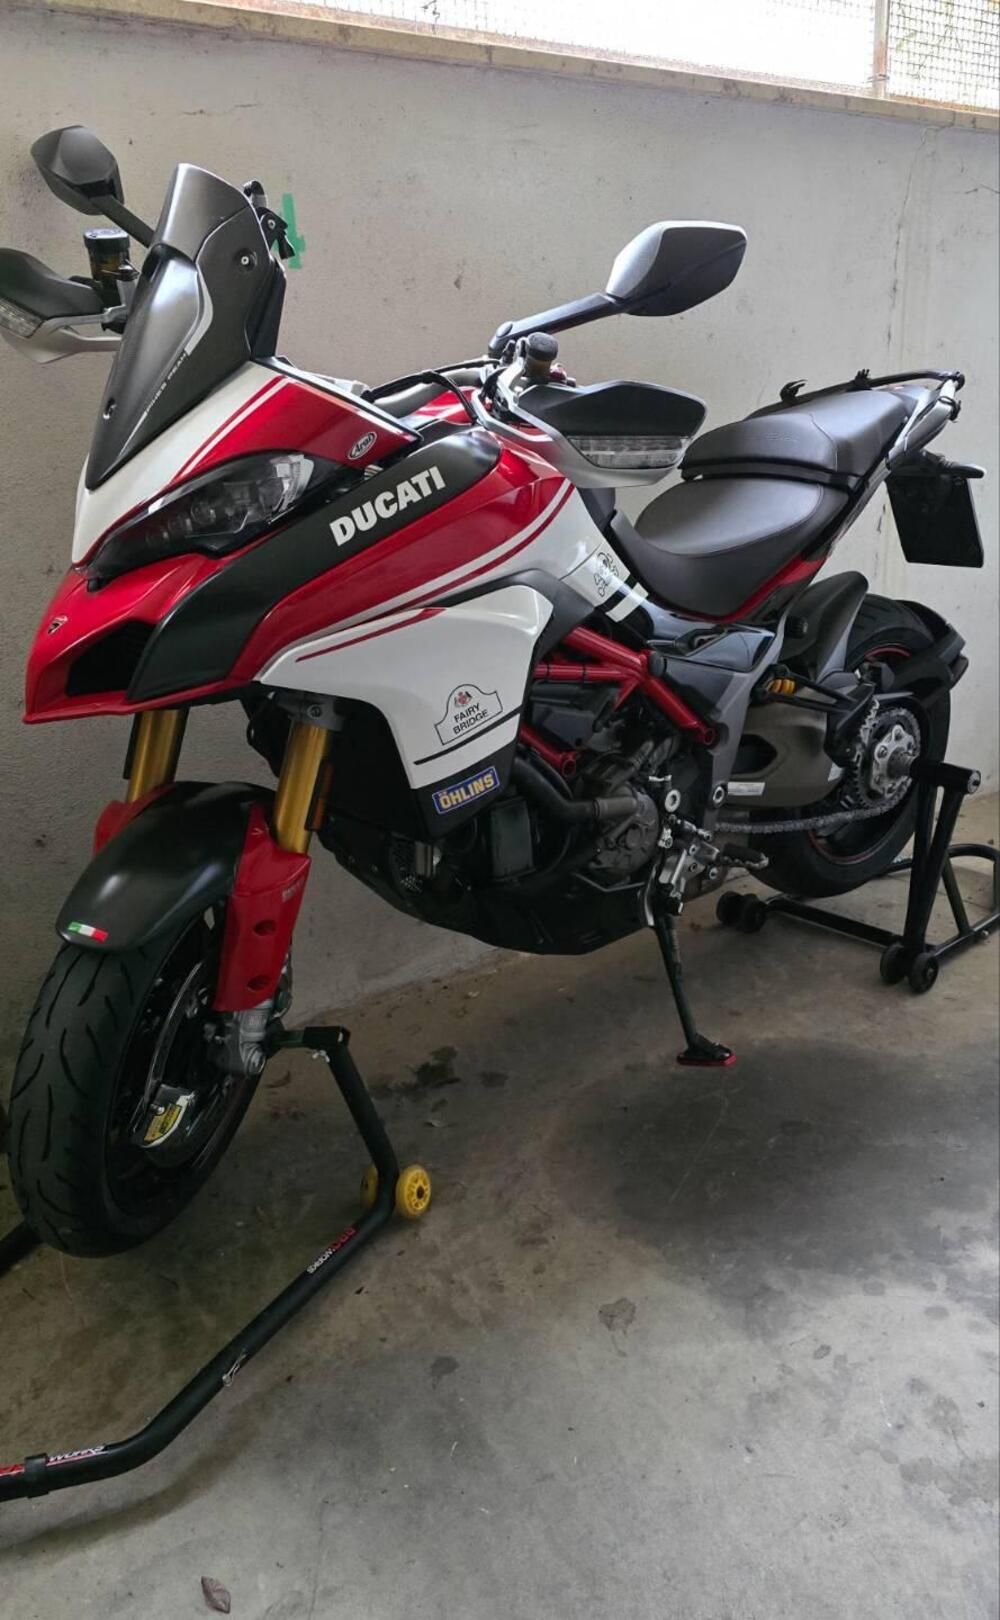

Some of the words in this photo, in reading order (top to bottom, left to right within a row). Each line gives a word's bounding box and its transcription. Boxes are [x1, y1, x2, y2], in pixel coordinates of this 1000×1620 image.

[329, 466, 446, 546] DUCATI
[453, 709, 489, 734] BRIDGE
[454, 702, 480, 722] FAIRY
[438, 774, 495, 810] ÖHLINS
